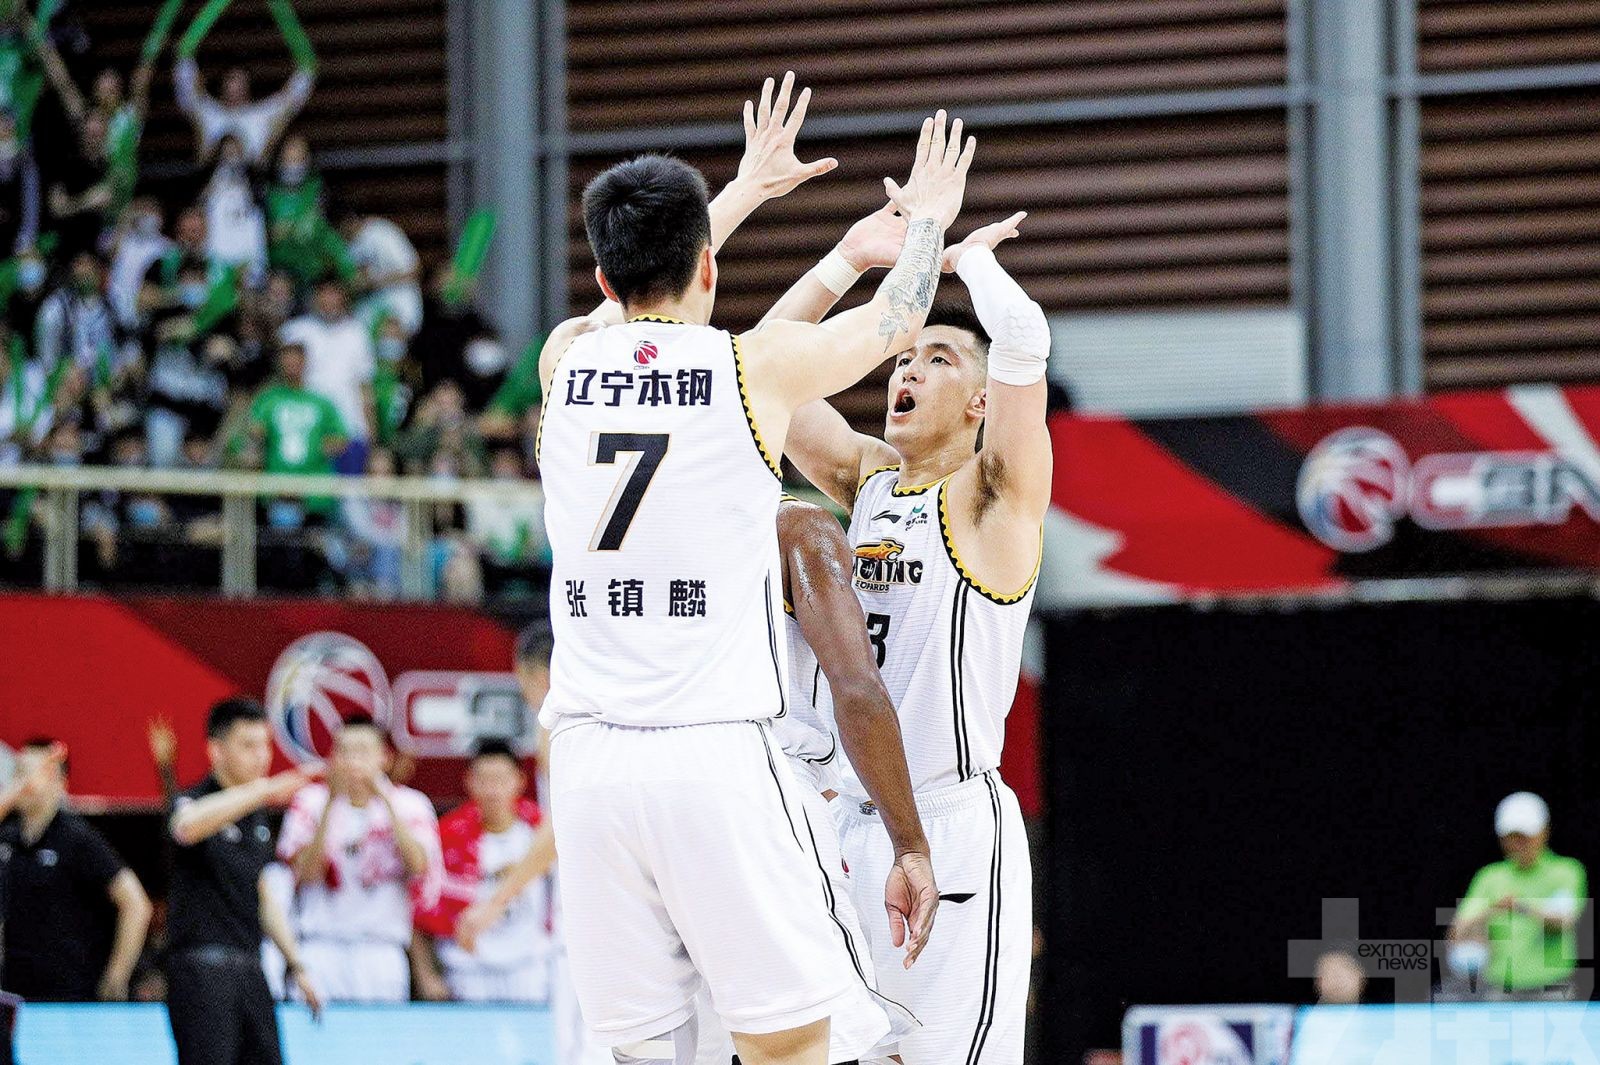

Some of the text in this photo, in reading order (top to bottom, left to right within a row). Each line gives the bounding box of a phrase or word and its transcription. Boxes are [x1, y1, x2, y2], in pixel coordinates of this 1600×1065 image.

[565, 369, 712, 406] 辽宁本钢
[587, 431, 671, 552] 7
[565, 579, 706, 617] 张镇麟
[865, 612, 891, 670] 3
